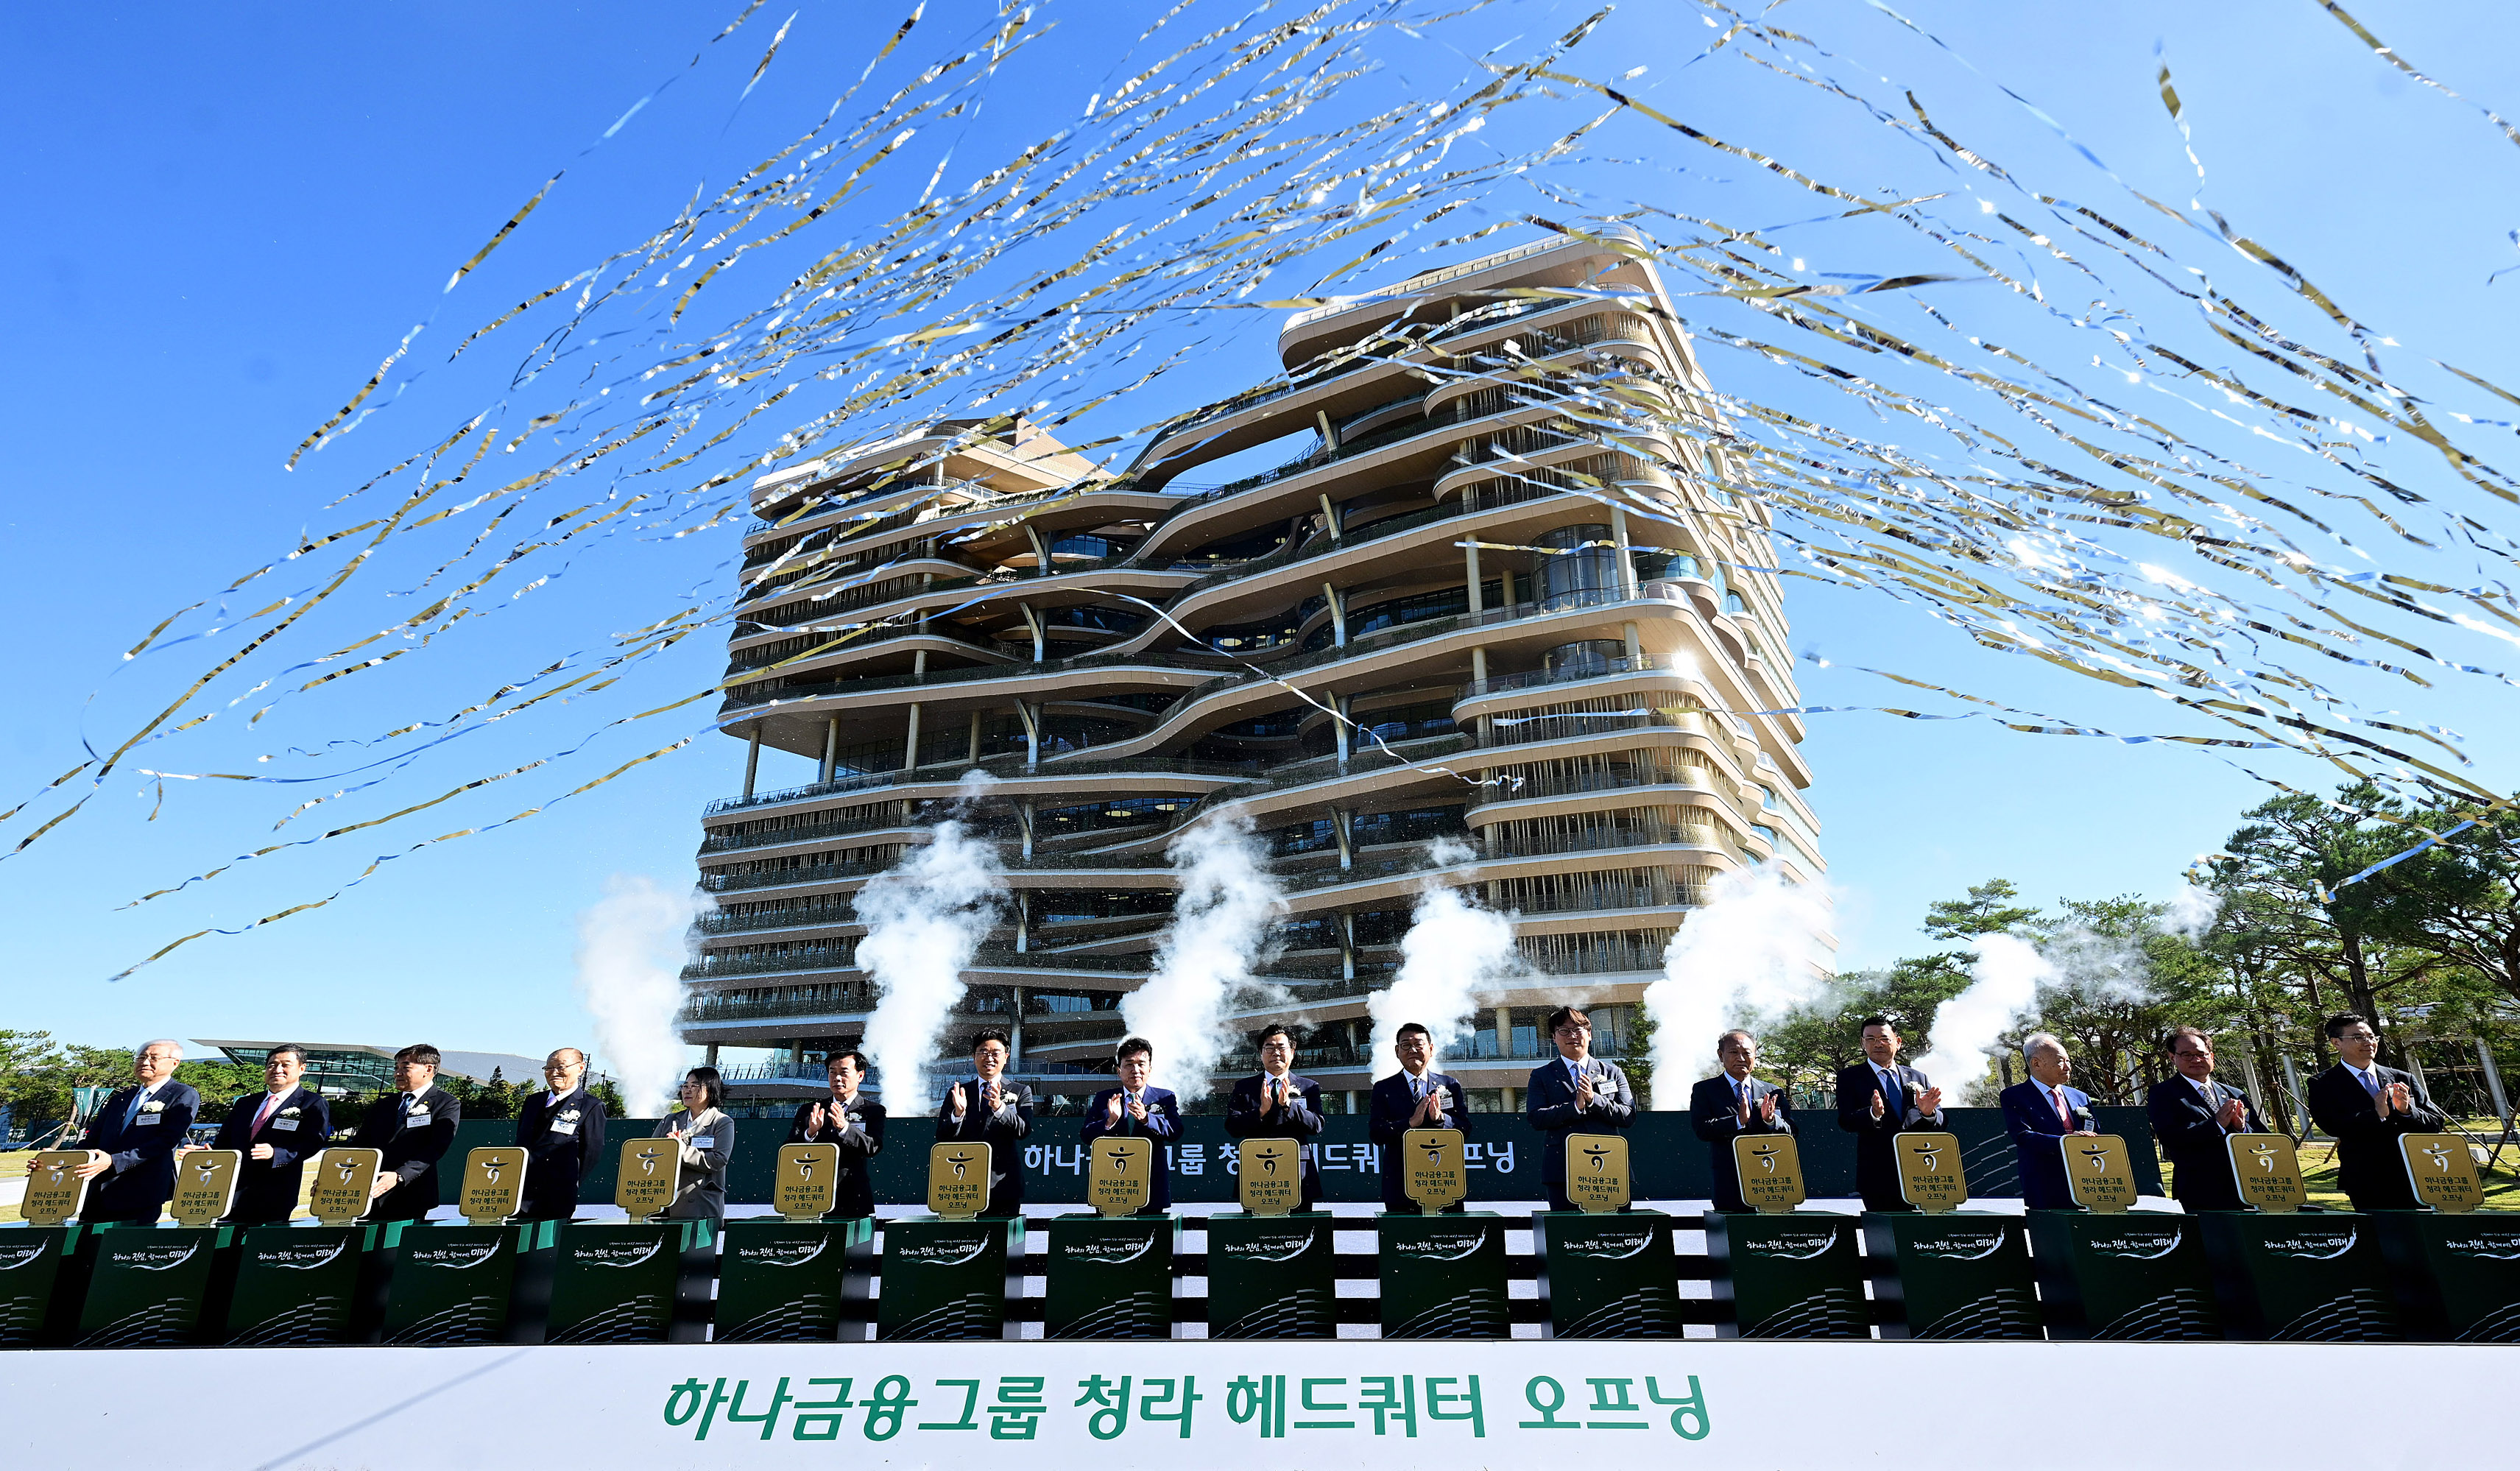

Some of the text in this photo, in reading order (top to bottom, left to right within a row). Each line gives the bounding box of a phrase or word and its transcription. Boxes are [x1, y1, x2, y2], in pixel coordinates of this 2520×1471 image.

[1024, 1143, 1206, 1176] 하나룹
[1415, 1171, 1455, 1179] 하나금융그룹
[1250, 1180, 1290, 1188] 하나금융그룹
[1578, 1177, 1618, 1185] 하나금융그룹
[1751, 1177, 1791, 1185] 하나금융그룹
[1913, 1176, 1954, 1184] 하나금융그룹
[2250, 1177, 2292, 1185] 하나금융그룹
[2425, 1177, 2468, 1185] 하나금융그룹
[786, 1185, 824, 1193] 하나금융그룹
[1098, 1188, 1139, 1196] 청라 헤드쿼터
[1751, 1185, 1794, 1193] 청라 헤드쿼터
[1913, 1184, 1957, 1192] 청라 헤드쿼터
[2082, 1185, 2126, 1193] 청라 헤드쿼터
[2251, 1185, 2295, 1193] 청라 헤드쿼터
[2427, 1185, 2472, 1193] 청라 헤드쿼터
[1249, 1189, 1291, 1197] 청라 헤드쿼터
[1927, 1192, 1947, 1201] 오프닝
[1108, 1196, 1127, 1204] 오프닝
[1261, 1197, 1280, 1205] 오프닝
[1589, 1193, 1609, 1202] 오프닝
[1765, 1193, 1785, 1202] 오프닝
[2096, 1194, 2117, 1202] 오프닝
[2265, 1193, 2286, 1202] 오프닝
[2443, 1193, 2463, 1202] 오프닝
[328, 1205, 347, 1213] 오프닝
[479, 1205, 498, 1213] 오프닝
[793, 1202, 813, 1210] 오프닝
[947, 1201, 967, 1209] 오프닝
[1285, 1241, 1303, 1249] 미래
[1457, 1240, 1475, 1249] 미래
[1625, 1238, 1642, 1247] 미래
[1808, 1238, 1827, 1247] 미래
[1976, 1238, 1994, 1248] 미래
[2153, 1238, 2173, 1247] 미래
[2328, 1238, 2347, 1247] 미래
[633, 1246, 651, 1256] 미래
[799, 1246, 816, 1255] 미래
[960, 1244, 978, 1254] 미래
[1126, 1243, 1143, 1252] 미래
[17, 1249, 35, 1259] 미래
[169, 1250, 187, 1259] 미래
[316, 1249, 333, 1258] 미래
[471, 1249, 489, 1257] 미래
[665, 1375, 1709, 1441] 하나금융그룹 청라 헤드쿼터 오프닝
